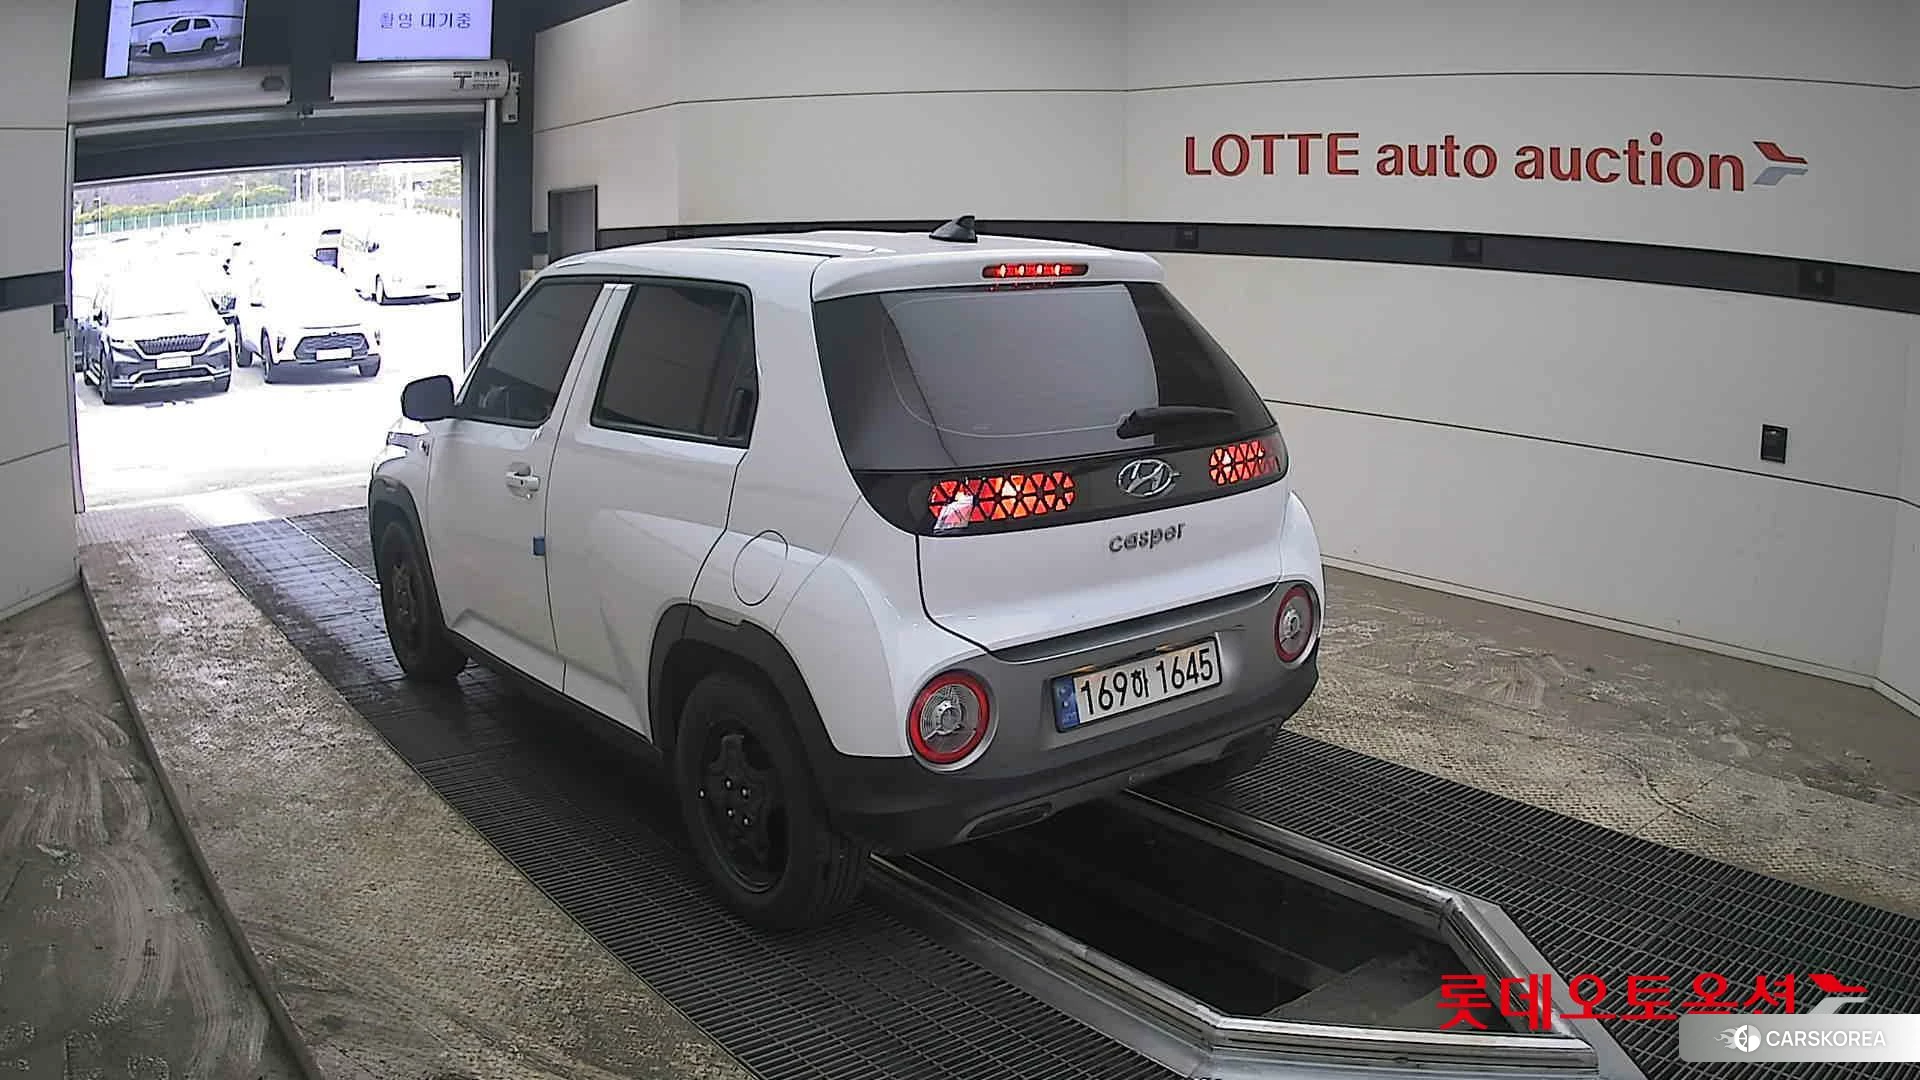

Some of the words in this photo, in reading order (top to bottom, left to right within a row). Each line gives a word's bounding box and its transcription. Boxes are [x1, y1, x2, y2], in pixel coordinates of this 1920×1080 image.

[420, 11, 472, 30] 대기중
[1185, 132, 1360, 177] LOTTE
[1375, 134, 1498, 179] auto
[1514, 131, 1745, 192] auction
[1108, 522, 1187, 553] casper
[1080, 667, 1150, 716] 169하
[1155, 648, 1214, 695] 1645
